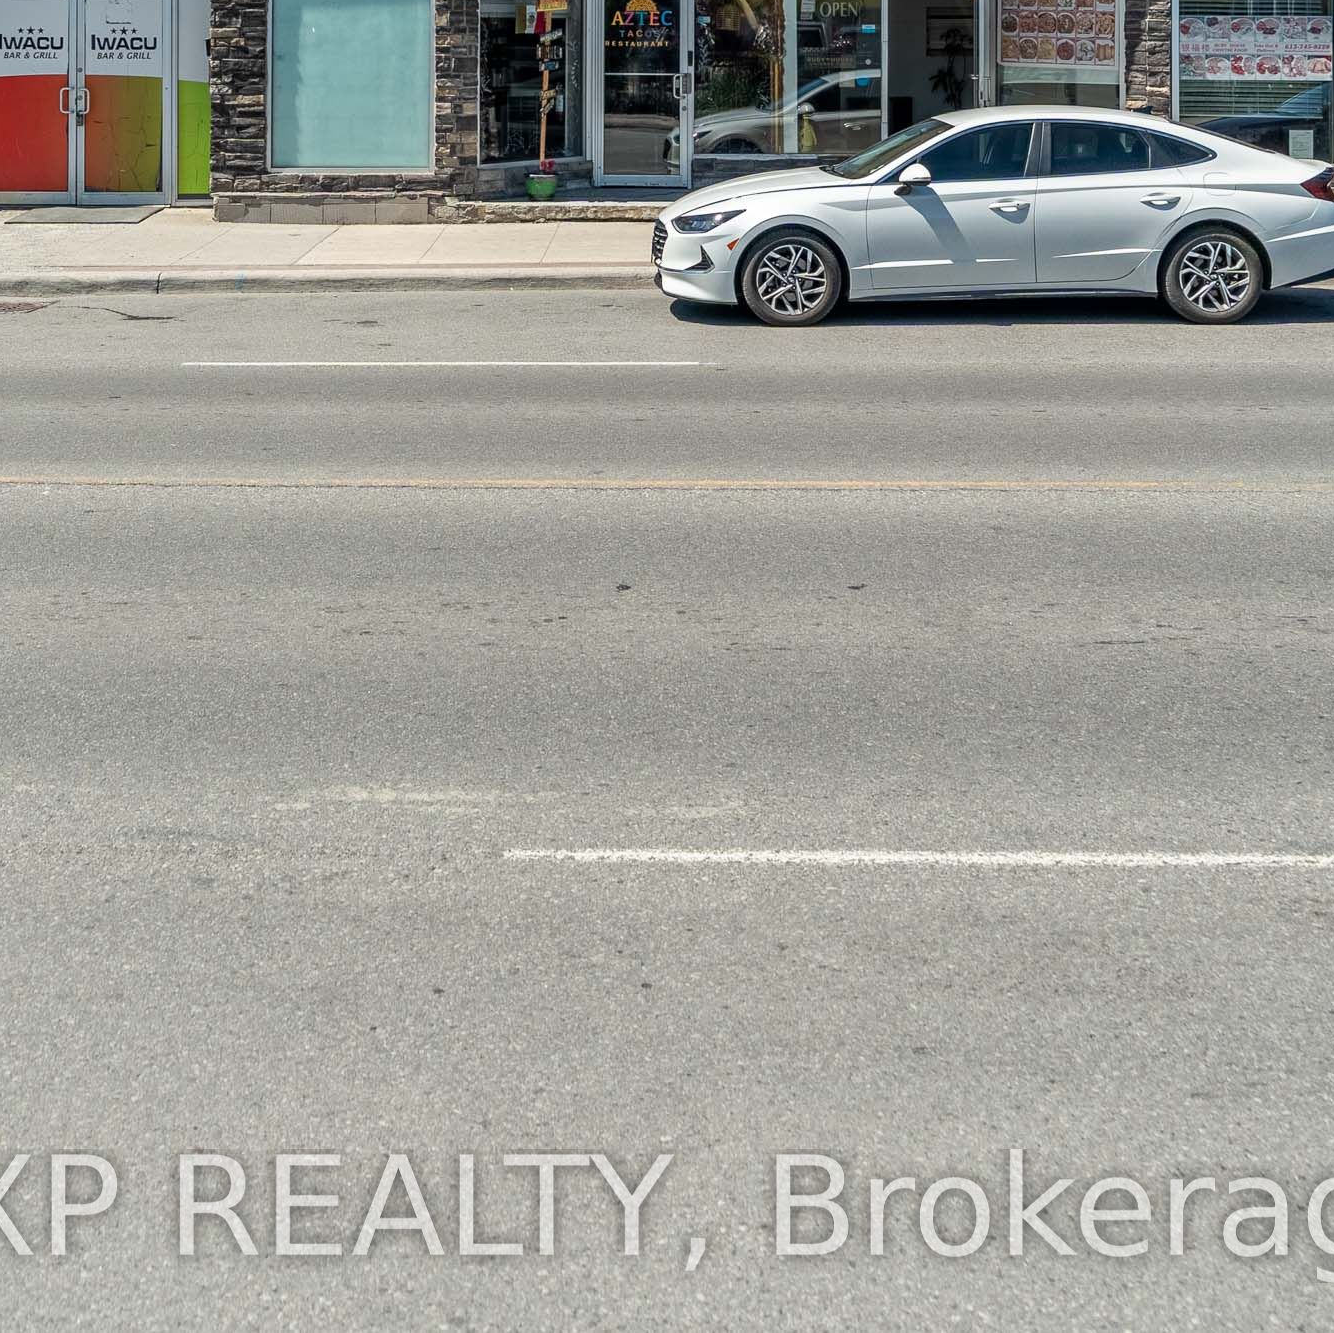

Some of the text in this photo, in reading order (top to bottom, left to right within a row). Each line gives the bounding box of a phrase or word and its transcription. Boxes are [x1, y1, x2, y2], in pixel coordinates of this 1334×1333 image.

[819, 1, 859, 17] OPEN
[611, 10, 673, 26] AZTEC
[619, 29, 660, 38] TACOS
[91, 34, 157, 51] IWACU
[127, 52, 152, 60] GRILL
